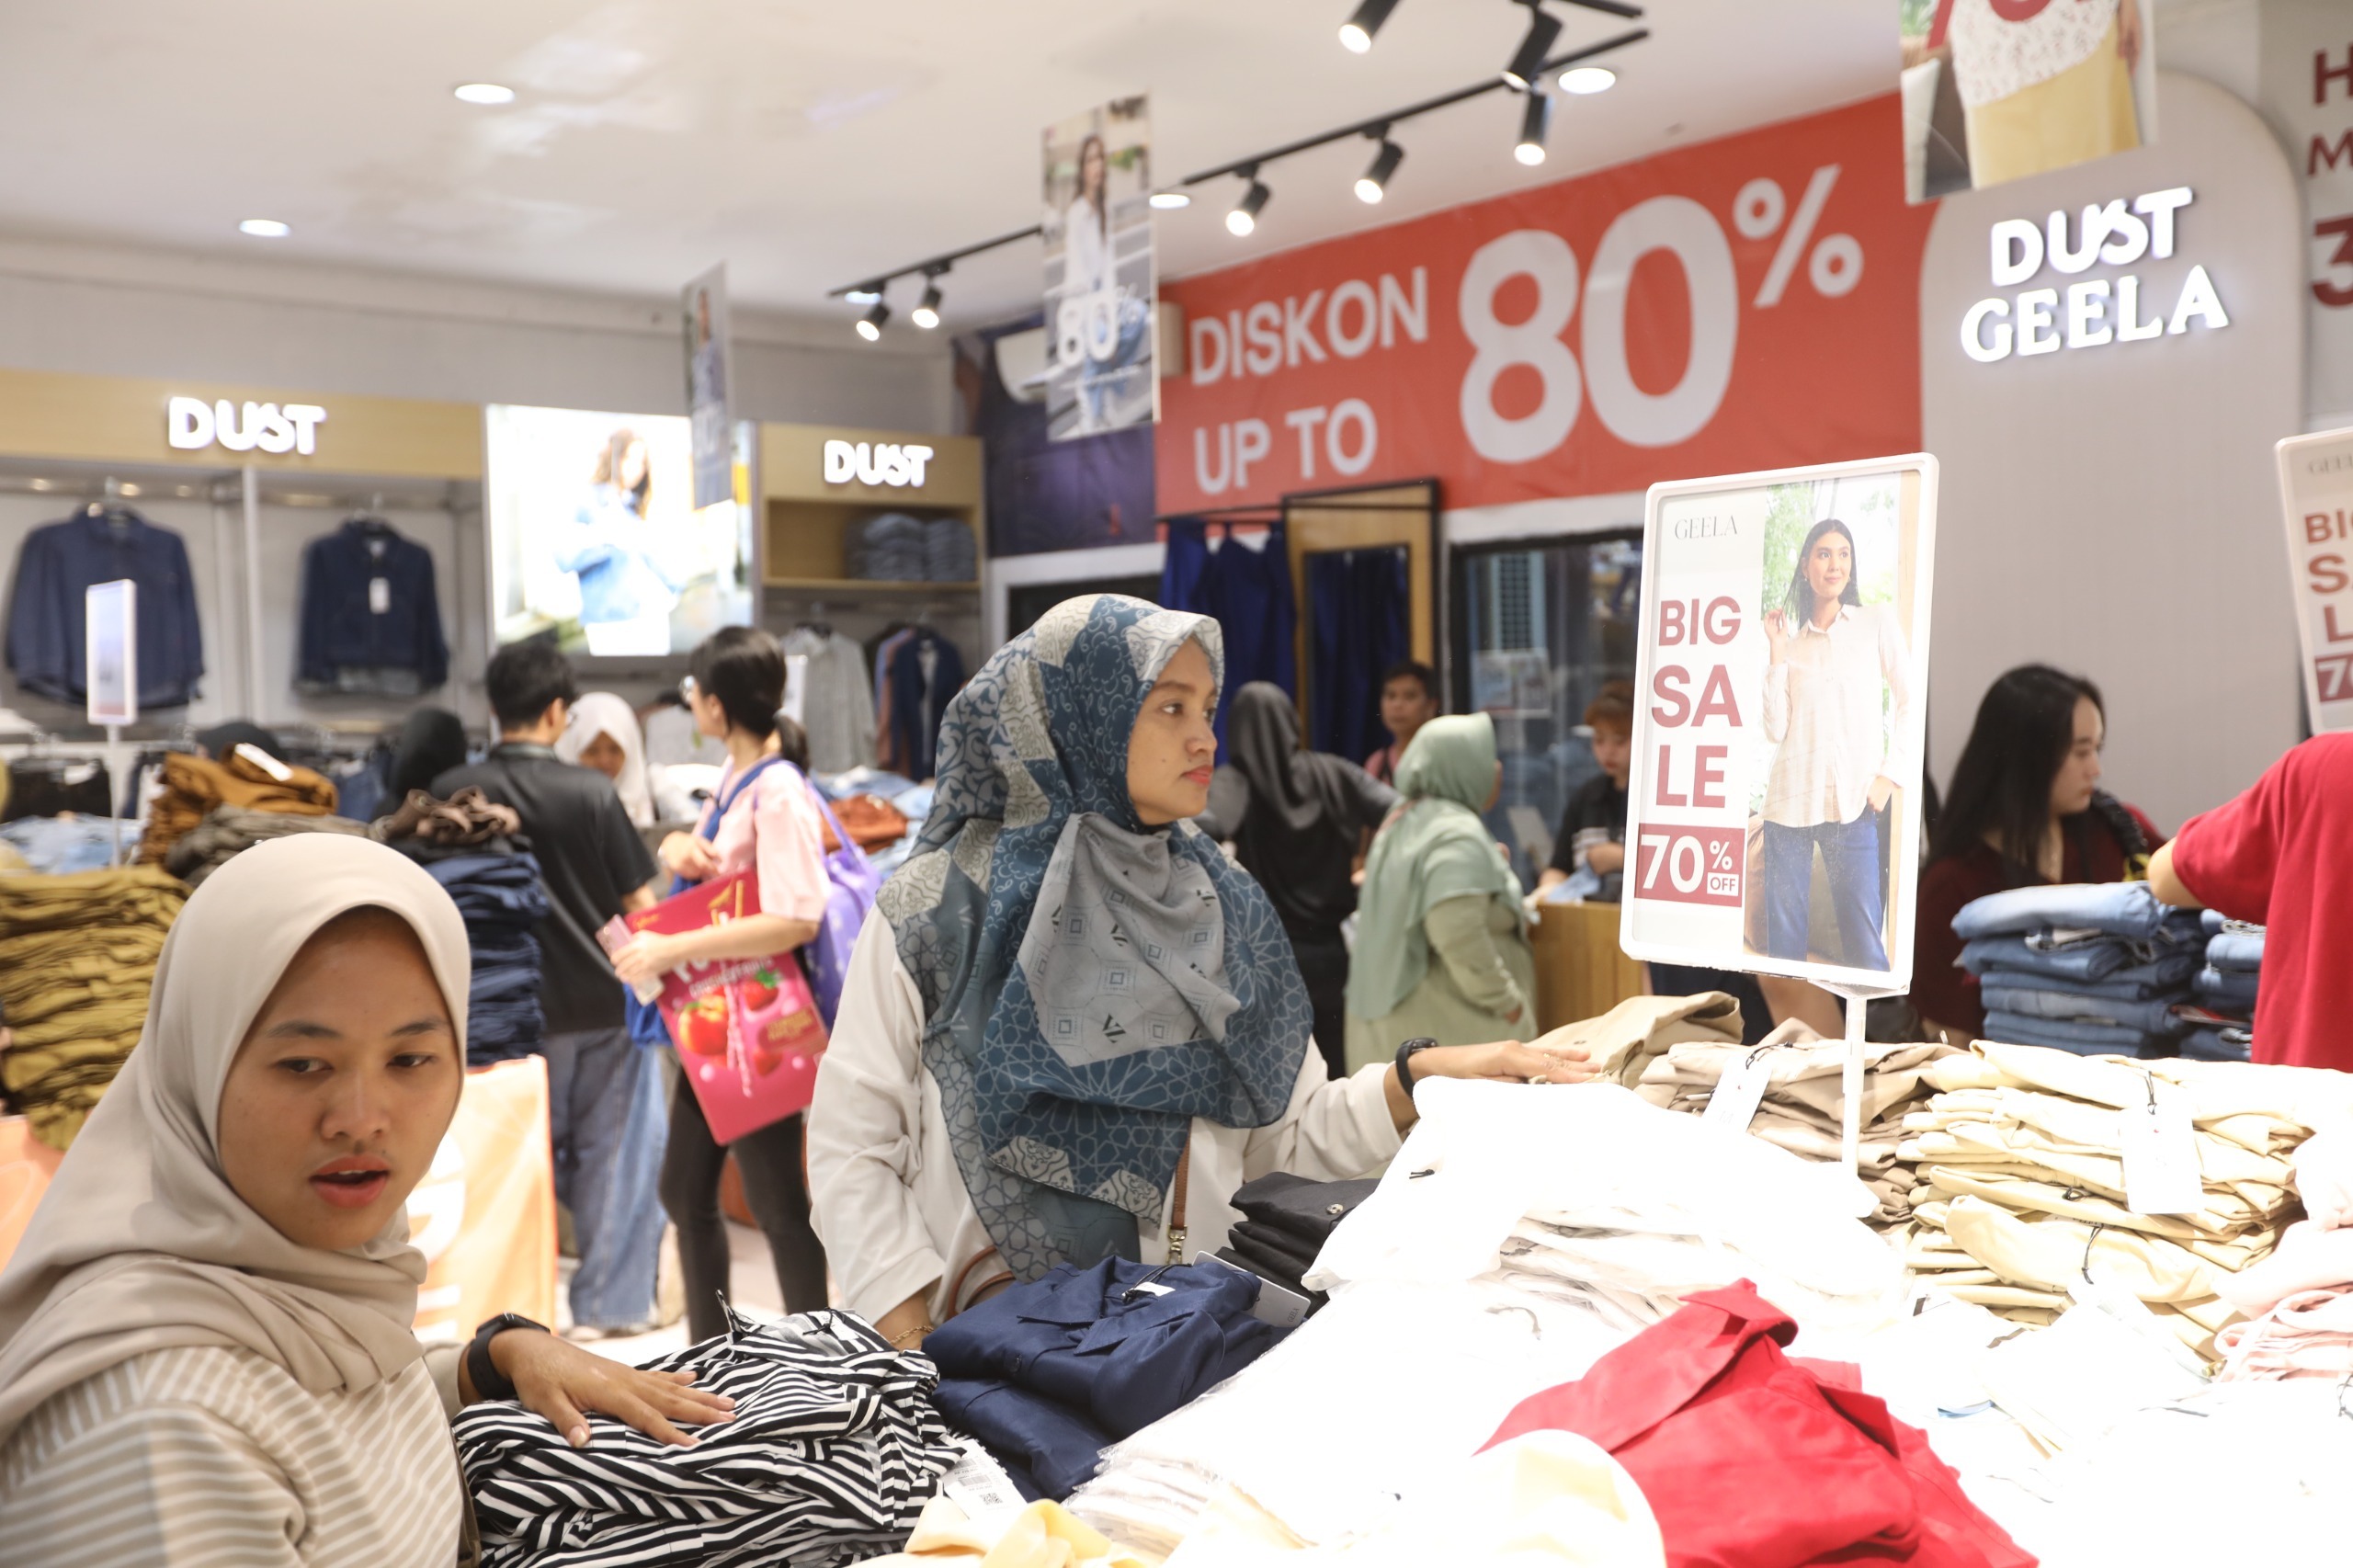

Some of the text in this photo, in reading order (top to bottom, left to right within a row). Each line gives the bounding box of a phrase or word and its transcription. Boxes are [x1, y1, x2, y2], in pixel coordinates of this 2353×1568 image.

[1990, 186, 2194, 287] DUST
[1189, 164, 1864, 465] DISKON 80%
[1960, 264, 2230, 363] GEELA
[168, 396, 326, 454] DUST
[1194, 398, 1378, 495] UP TO
[824, 439, 933, 486] DUST
[1674, 515, 1739, 541] GEELA
[2304, 508, 2353, 544] BI
[1657, 596, 1742, 646] BIG
[1651, 664, 1743, 728] SA
[2316, 658, 2353, 699] 7
[1655, 744, 1729, 809] LE
[1640, 832, 1733, 893] 70%
[1710, 876, 1736, 893] OFF
